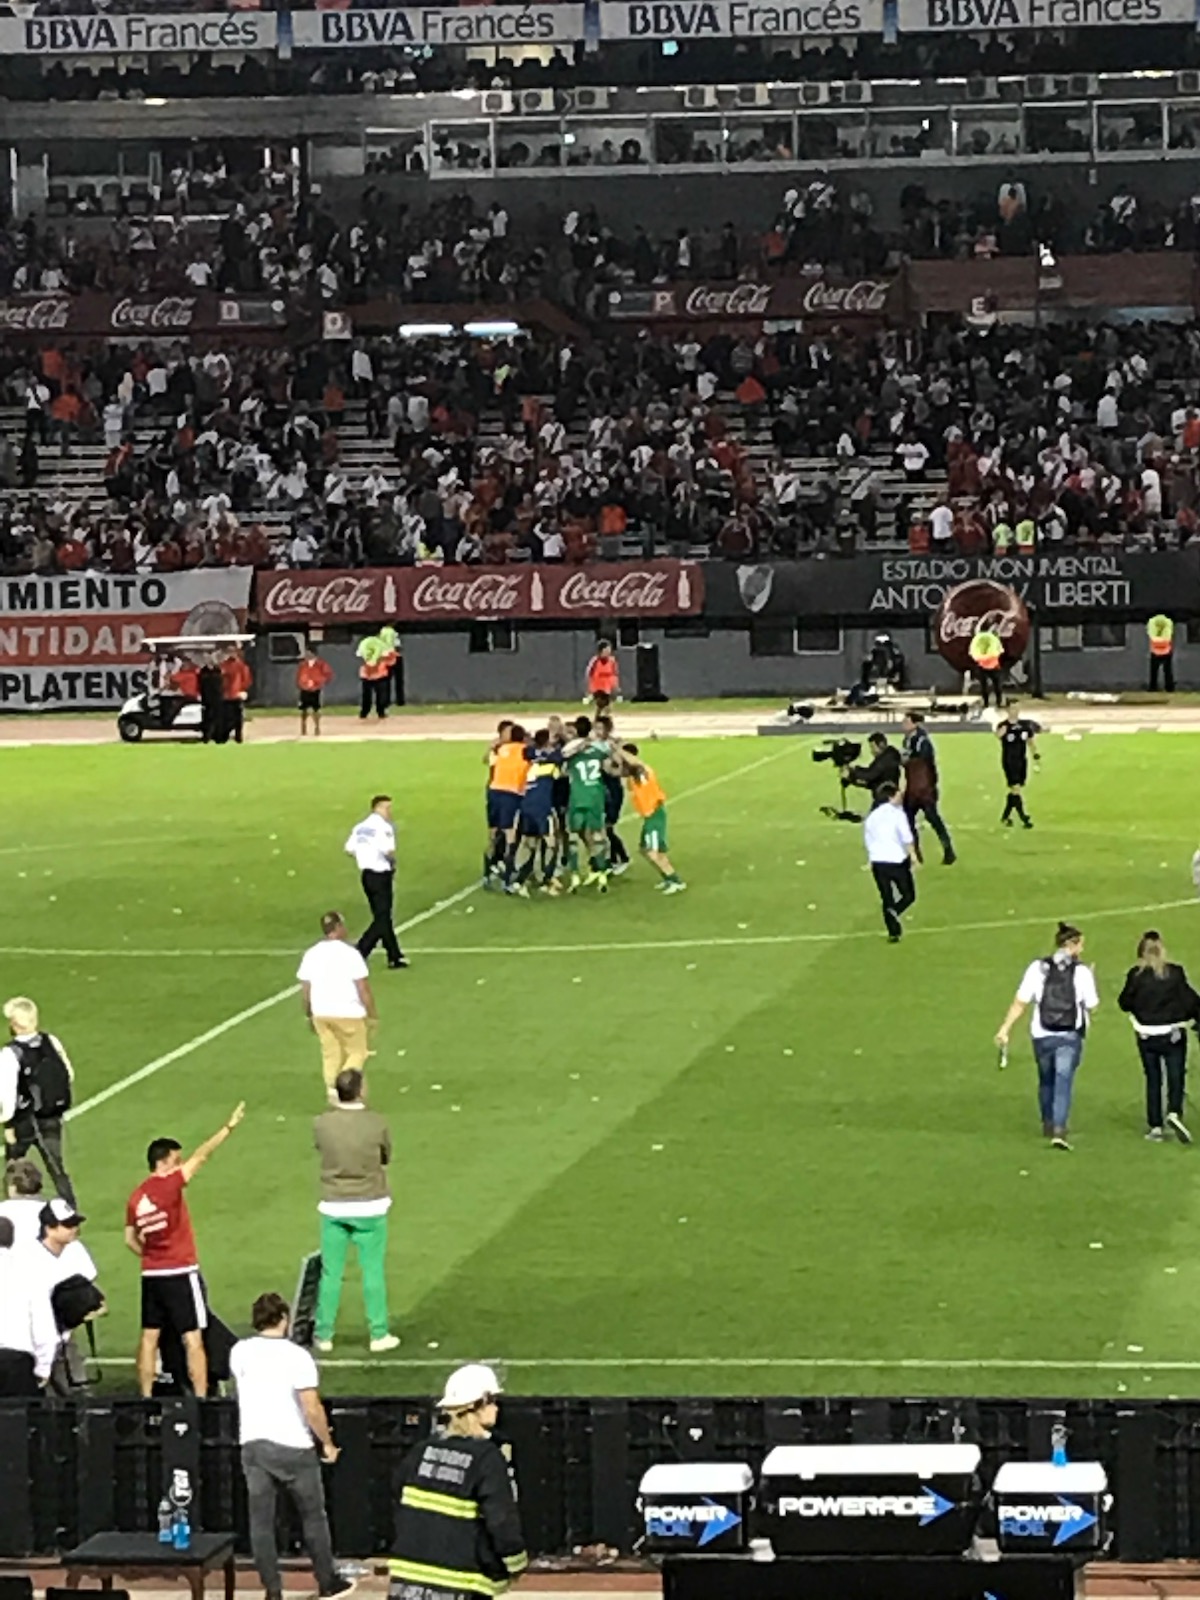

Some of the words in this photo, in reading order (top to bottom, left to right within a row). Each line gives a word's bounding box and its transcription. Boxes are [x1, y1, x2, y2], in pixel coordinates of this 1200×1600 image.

[322, 12, 414, 43] BBVA
[422, 4, 555, 40] Francés
[628, 3, 721, 35] BBVA
[729, 0, 862, 32] Francés
[928, 0, 1020, 27] BBVA
[25, 18, 118, 48] BBVA
[126, 11, 258, 47] Francés
[882, 559, 970, 581] ESTADIO
[0, 578, 167, 611] MIENTO
[1045, 580, 1131, 607] LIBERTI
[575, 759, 602, 781] 12
[644, 1505, 728, 1522] POWER
[778, 1495, 937, 1517] POWERADE
[998, 1505, 1085, 1522] POWER
